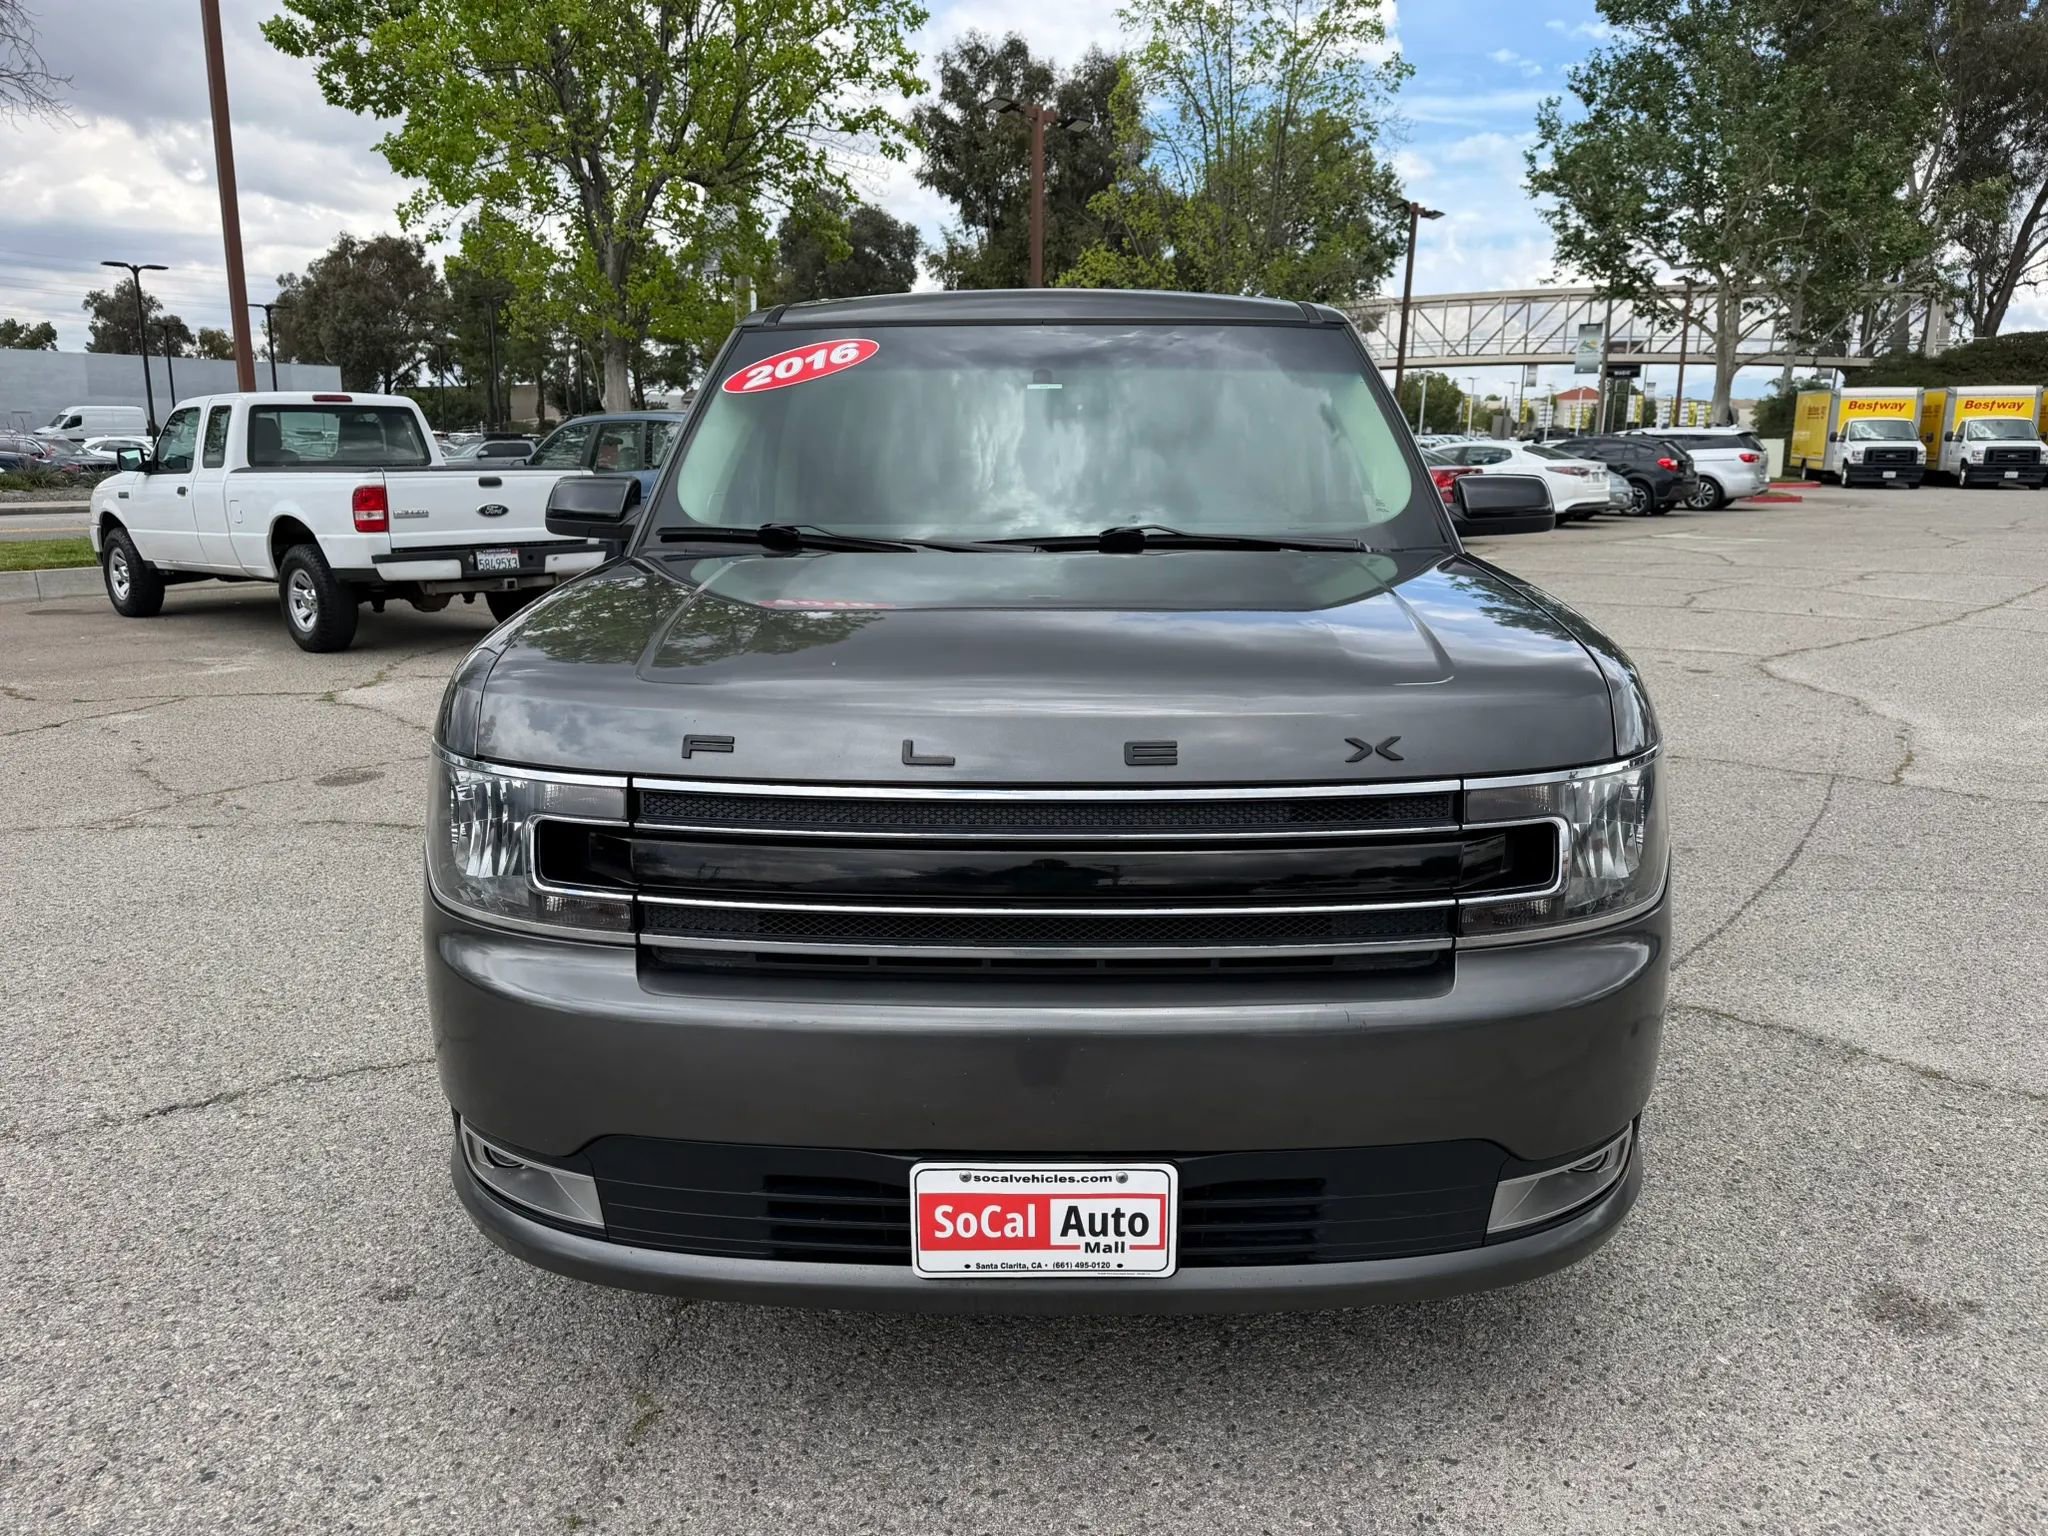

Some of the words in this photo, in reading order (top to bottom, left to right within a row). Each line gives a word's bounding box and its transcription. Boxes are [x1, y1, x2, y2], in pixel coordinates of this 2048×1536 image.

[742, 342, 860, 390] 2016
[1848, 400, 1906, 412] Bestway
[1964, 399, 2025, 411] Bestway
[973, 1172, 1112, 1184] socalvehicles.com
[934, 1203, 1036, 1238] SoCal
[1060, 1205, 1150, 1238] Auto
[1084, 1241, 1126, 1254] Mall
[975, 1262, 999, 1270] Santa
[1000, 1262, 1029, 1271] Clarita,
[1031, 1262, 1043, 1270] CA
[1052, 1261, 1073, 1271] (661)
[1074, 1261, 1111, 1270] 495-0120
